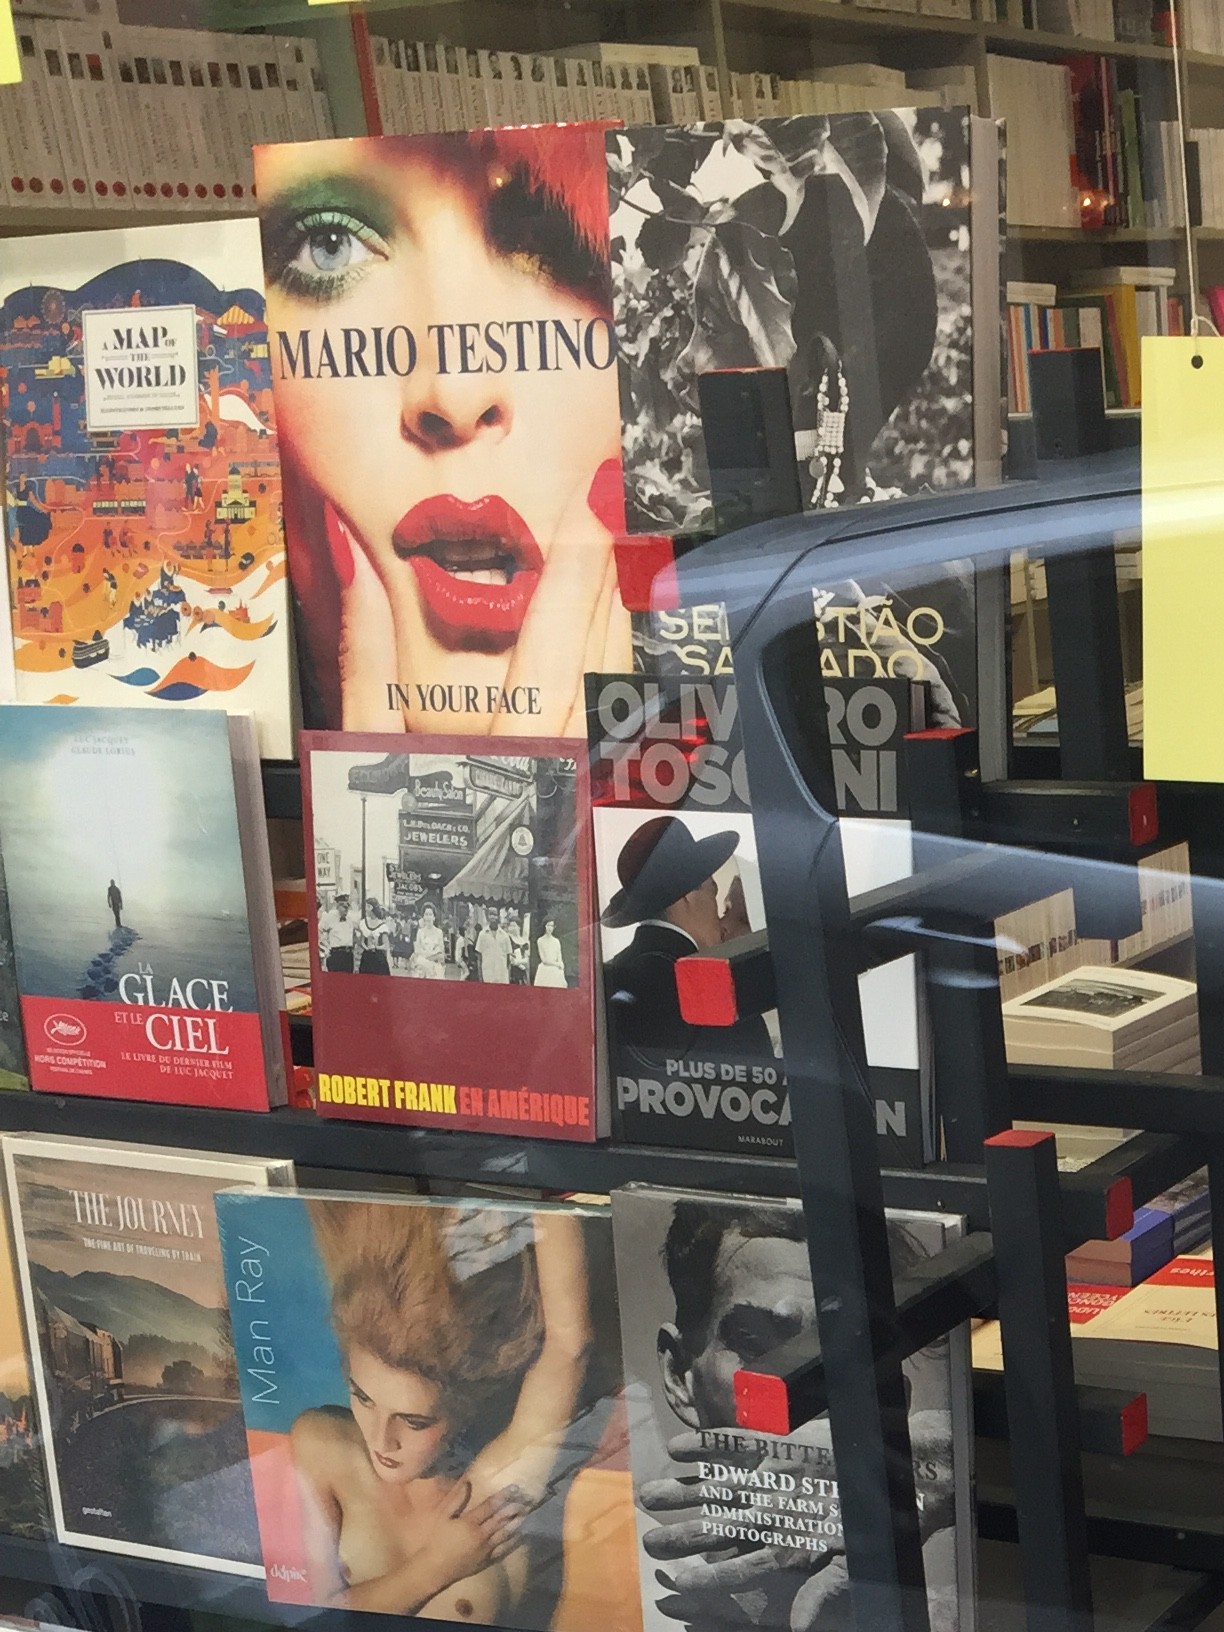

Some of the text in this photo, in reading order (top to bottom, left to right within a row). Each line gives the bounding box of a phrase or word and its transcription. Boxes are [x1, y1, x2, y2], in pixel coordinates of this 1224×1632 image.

[113, 326, 168, 350] MAP
[277, 317, 617, 380] MARIO TESTINO
[130, 353, 151, 362] THE
[95, 365, 186, 390] WORLD
[386, 683, 542, 715] IN YOUR FACE
[443, 782, 463, 800] Salon
[404, 832, 468, 847] JEWELERS
[318, 852, 330, 864] ONE
[138, 962, 153, 974] LA
[119, 973, 233, 1013] GLACE
[115, 1012, 143, 1025] ET LE
[146, 1014, 229, 1055] CIEL
[35, 1054, 55, 1064] HORS
[121, 1052, 232, 1070] LE LIVRE DU DERNIER FILM
[160, 1065, 233, 1080] DE LUC JACQUET
[666, 1059, 777, 1085] PLUS DE 50
[318, 1074, 589, 1128] ROBERT FRANK EN AMÉRIQUE
[738, 1135, 784, 1147] MARABOUT
[69, 1190, 204, 1238] THE JOURNEY
[83, 1237, 95, 1249] THE
[126, 1243, 133, 1253] OF
[235, 1236, 280, 1404] Man Ray
[699, 1430, 746, 1454] THE
[697, 1461, 795, 1492] EDWARD
[699, 1485, 733, 1501] AND
[738, 1490, 773, 1508] THE
[778, 1496, 824, 1515] FARM
[702, 1521, 828, 1552] PHOTOGRAPHS
